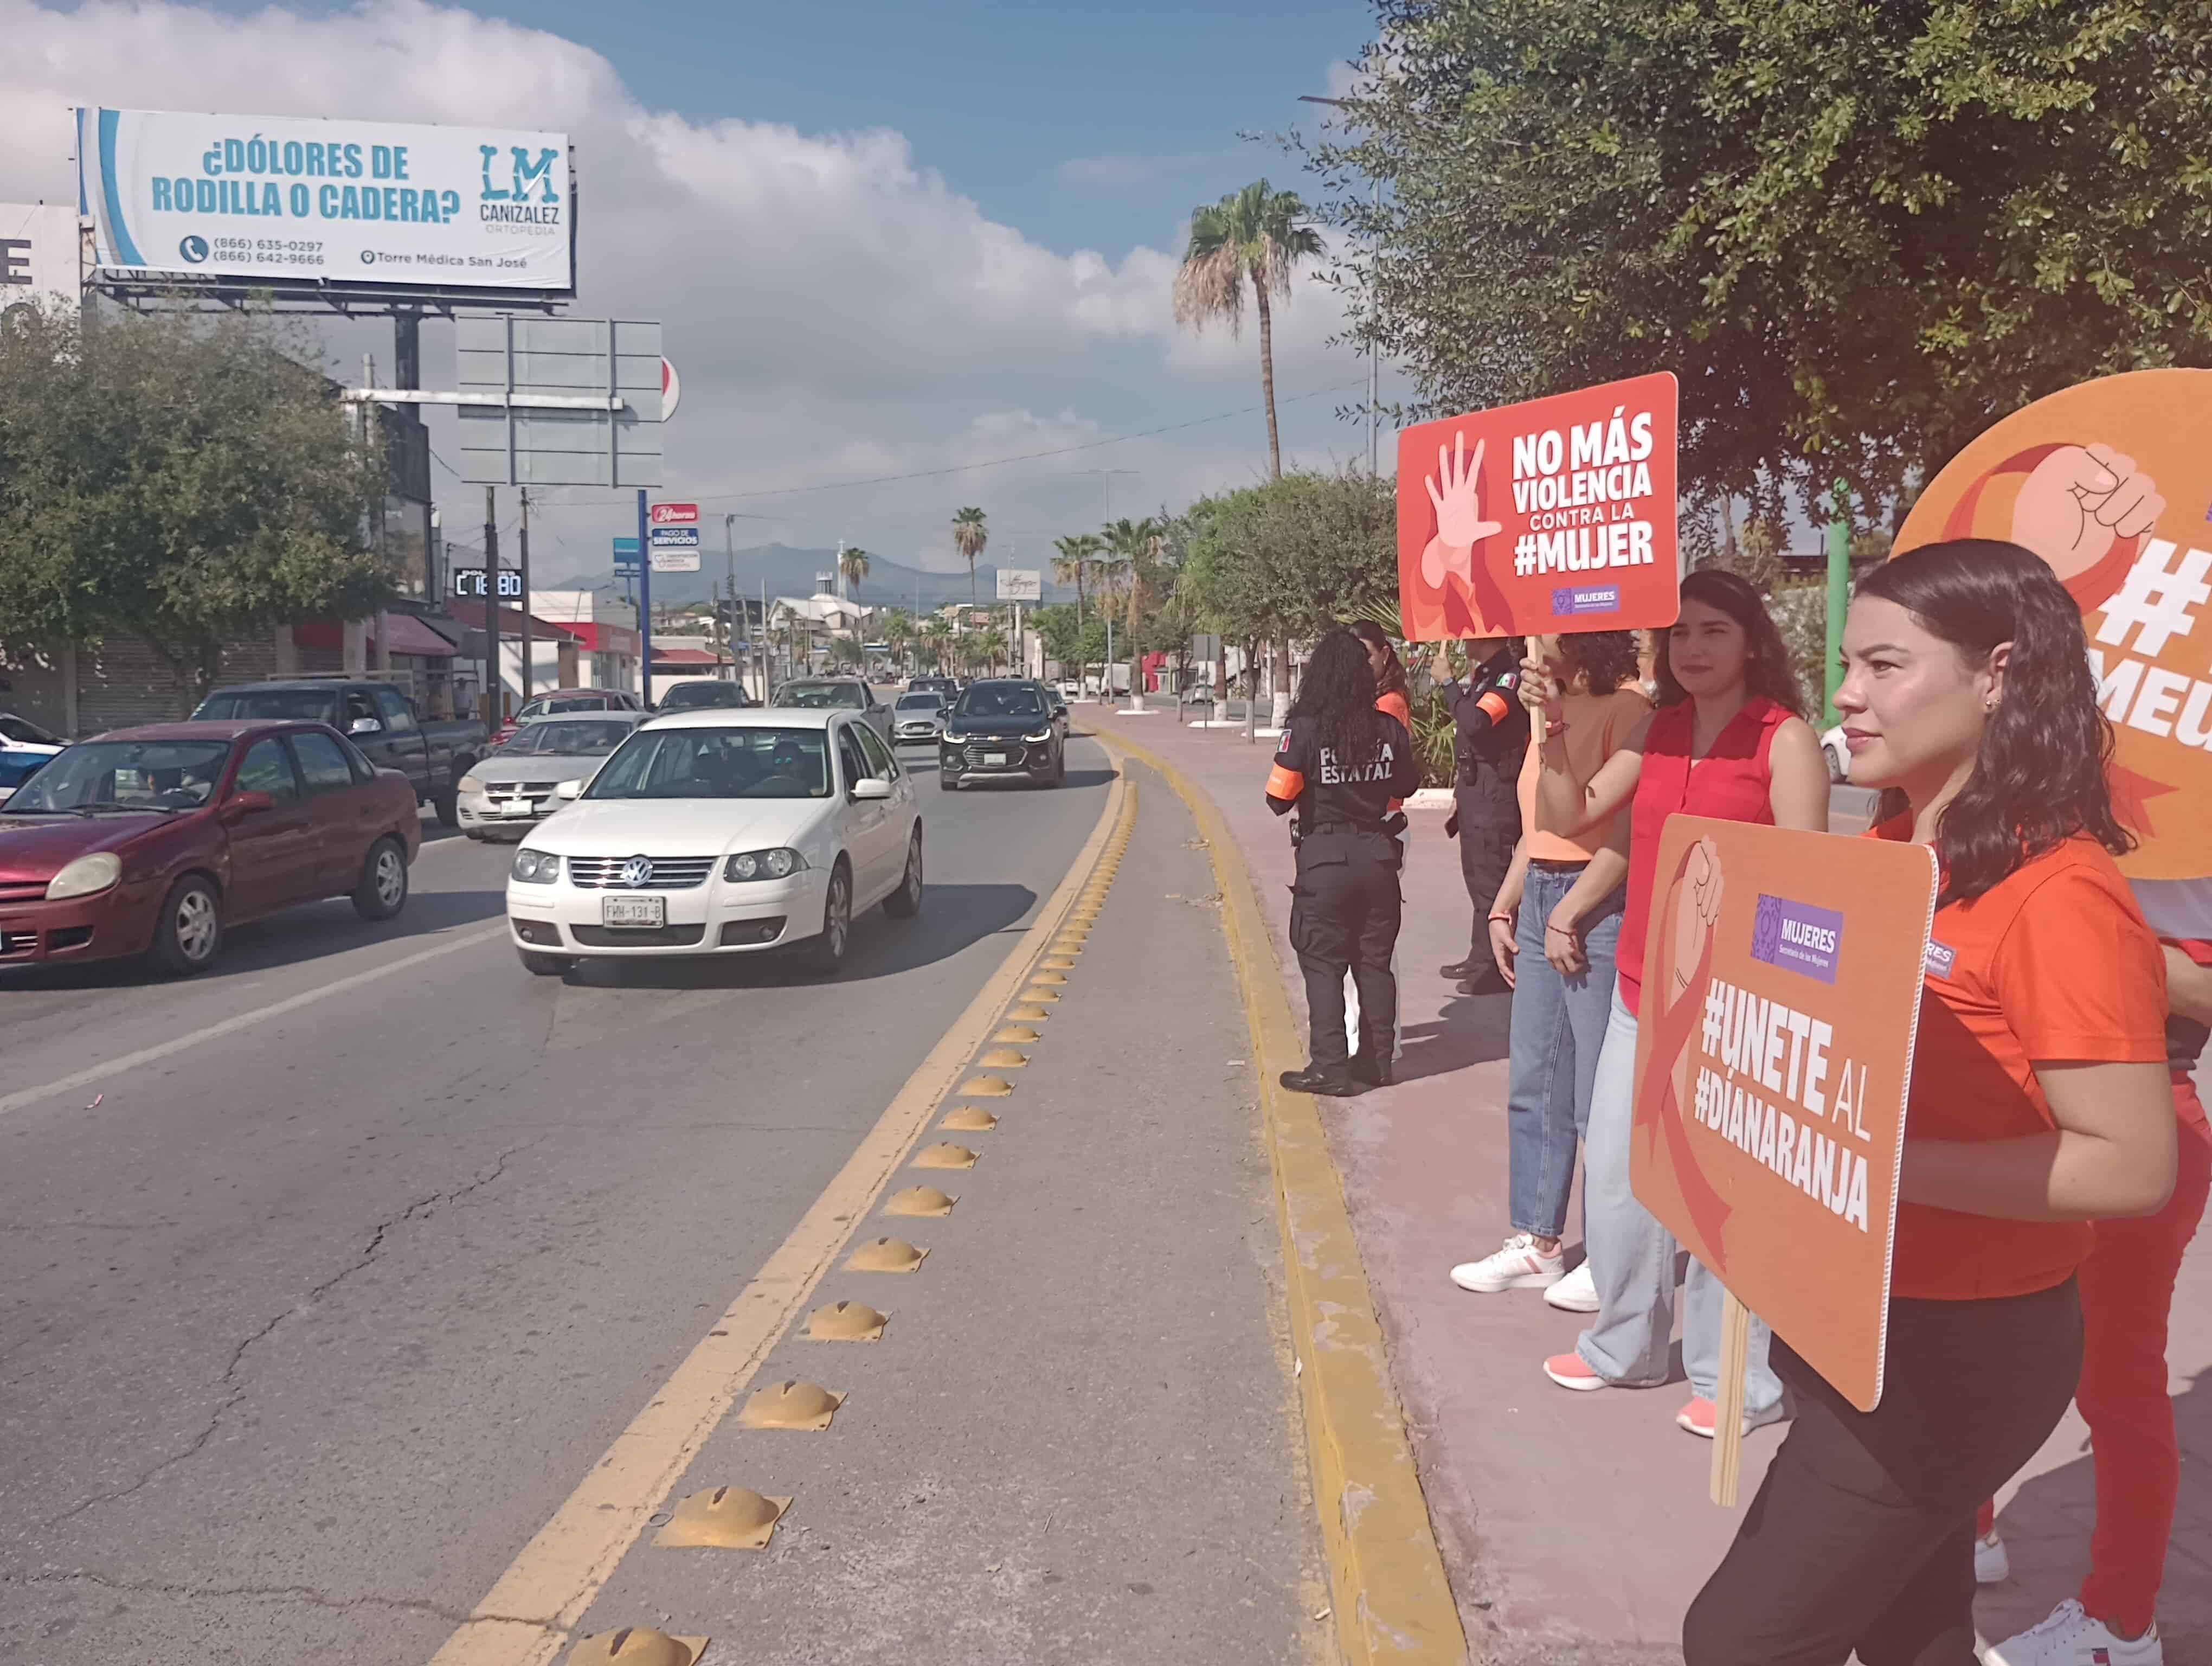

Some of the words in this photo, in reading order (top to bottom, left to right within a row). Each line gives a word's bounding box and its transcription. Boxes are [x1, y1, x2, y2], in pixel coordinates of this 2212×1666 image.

[371, 145, 409, 180] DE
[151, 176, 282, 216] RODILLA
[290, 183, 310, 217] O
[319, 184, 460, 224] CADERA?
[480, 203, 560, 225] CANIZALEZ
[214, 238, 253, 250] (866)
[256, 239, 323, 252] 635-0297
[485, 224, 556, 236] ORTOPEDIA
[213, 251, 252, 263] (866)
[256, 252, 325, 265] 642-9666
[377, 252, 412, 264] Torre
[416, 253, 465, 266] Médica
[468, 257, 493, 267] San
[496, 257, 528, 269] José
[1512, 430, 1563, 480] NO
[1570, 405, 1653, 471] MÁS
[1512, 462, 1653, 514] VIOLENCIA
[1529, 506, 1604, 531] CONTRA
[1610, 502, 1635, 521] LA
[653, 536, 698, 545] SERVICIOS
[1513, 521, 1654, 576] #MUJER
[1574, 591, 1615, 603] MUJERES
[2087, 647, 2212, 752] MEU
[1781, 918, 1836, 954] MUJERES
[1701, 977, 1833, 1117] #UNETE
[1831, 1058, 1871, 1142] AL
[1694, 1065, 1868, 1233] #DÍANARANJA
